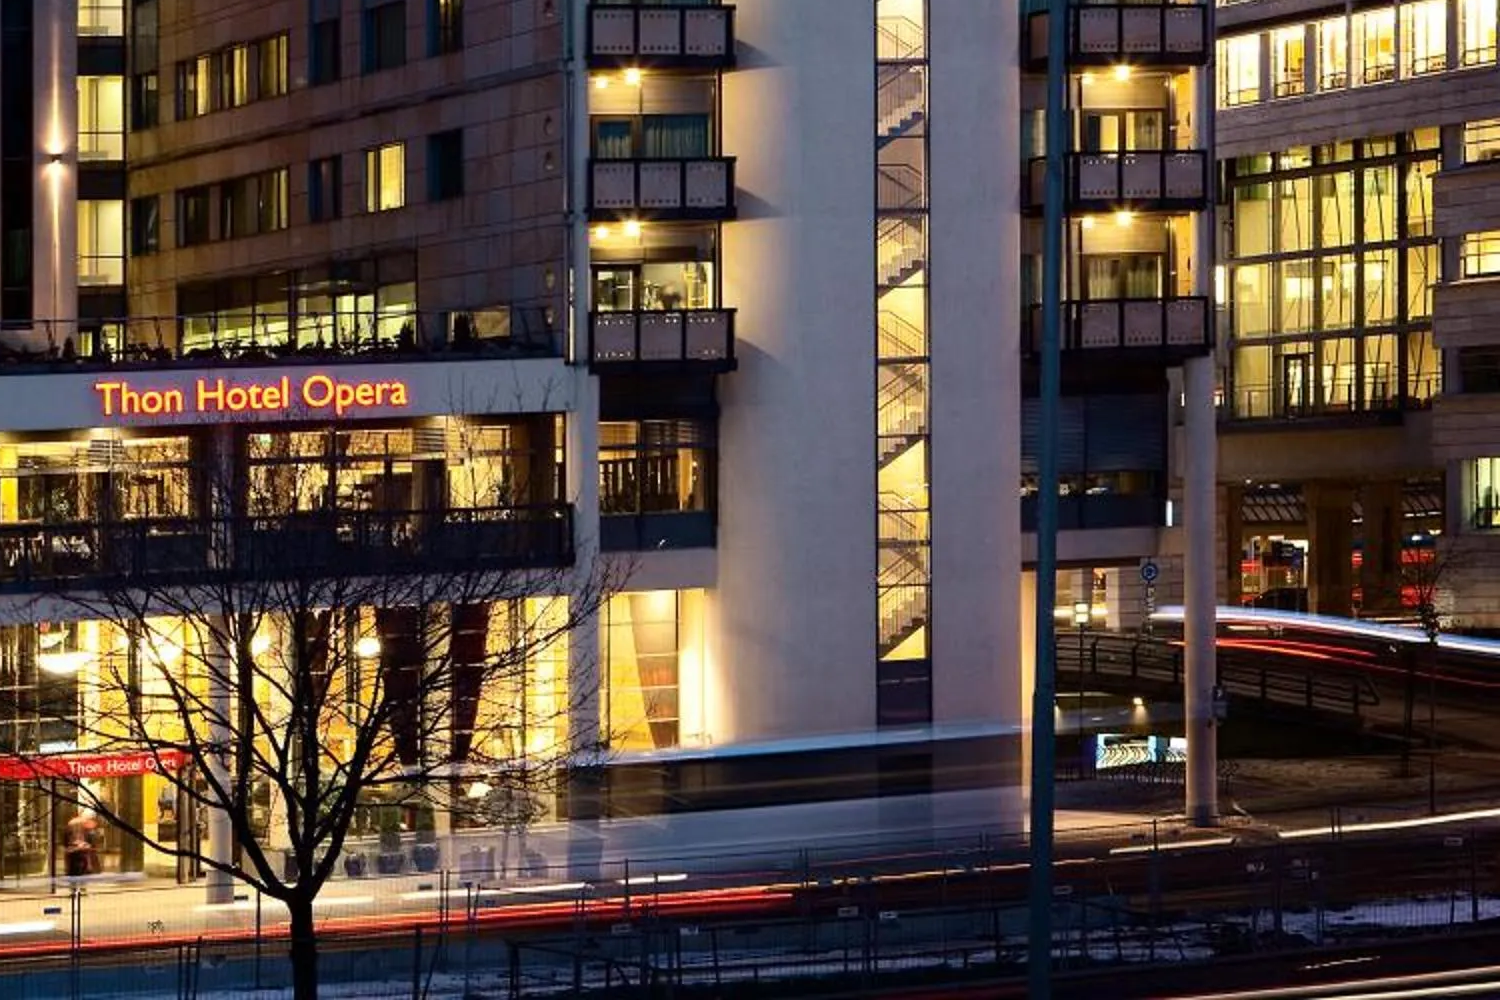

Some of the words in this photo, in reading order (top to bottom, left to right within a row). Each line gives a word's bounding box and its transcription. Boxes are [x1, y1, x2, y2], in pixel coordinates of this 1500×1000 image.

[94, 380, 184, 416] Thon
[197, 375, 290, 412] Hotel
[302, 374, 407, 416] Opera
[67, 760, 102, 775] Thon
[106, 758, 142, 773] Hotel
